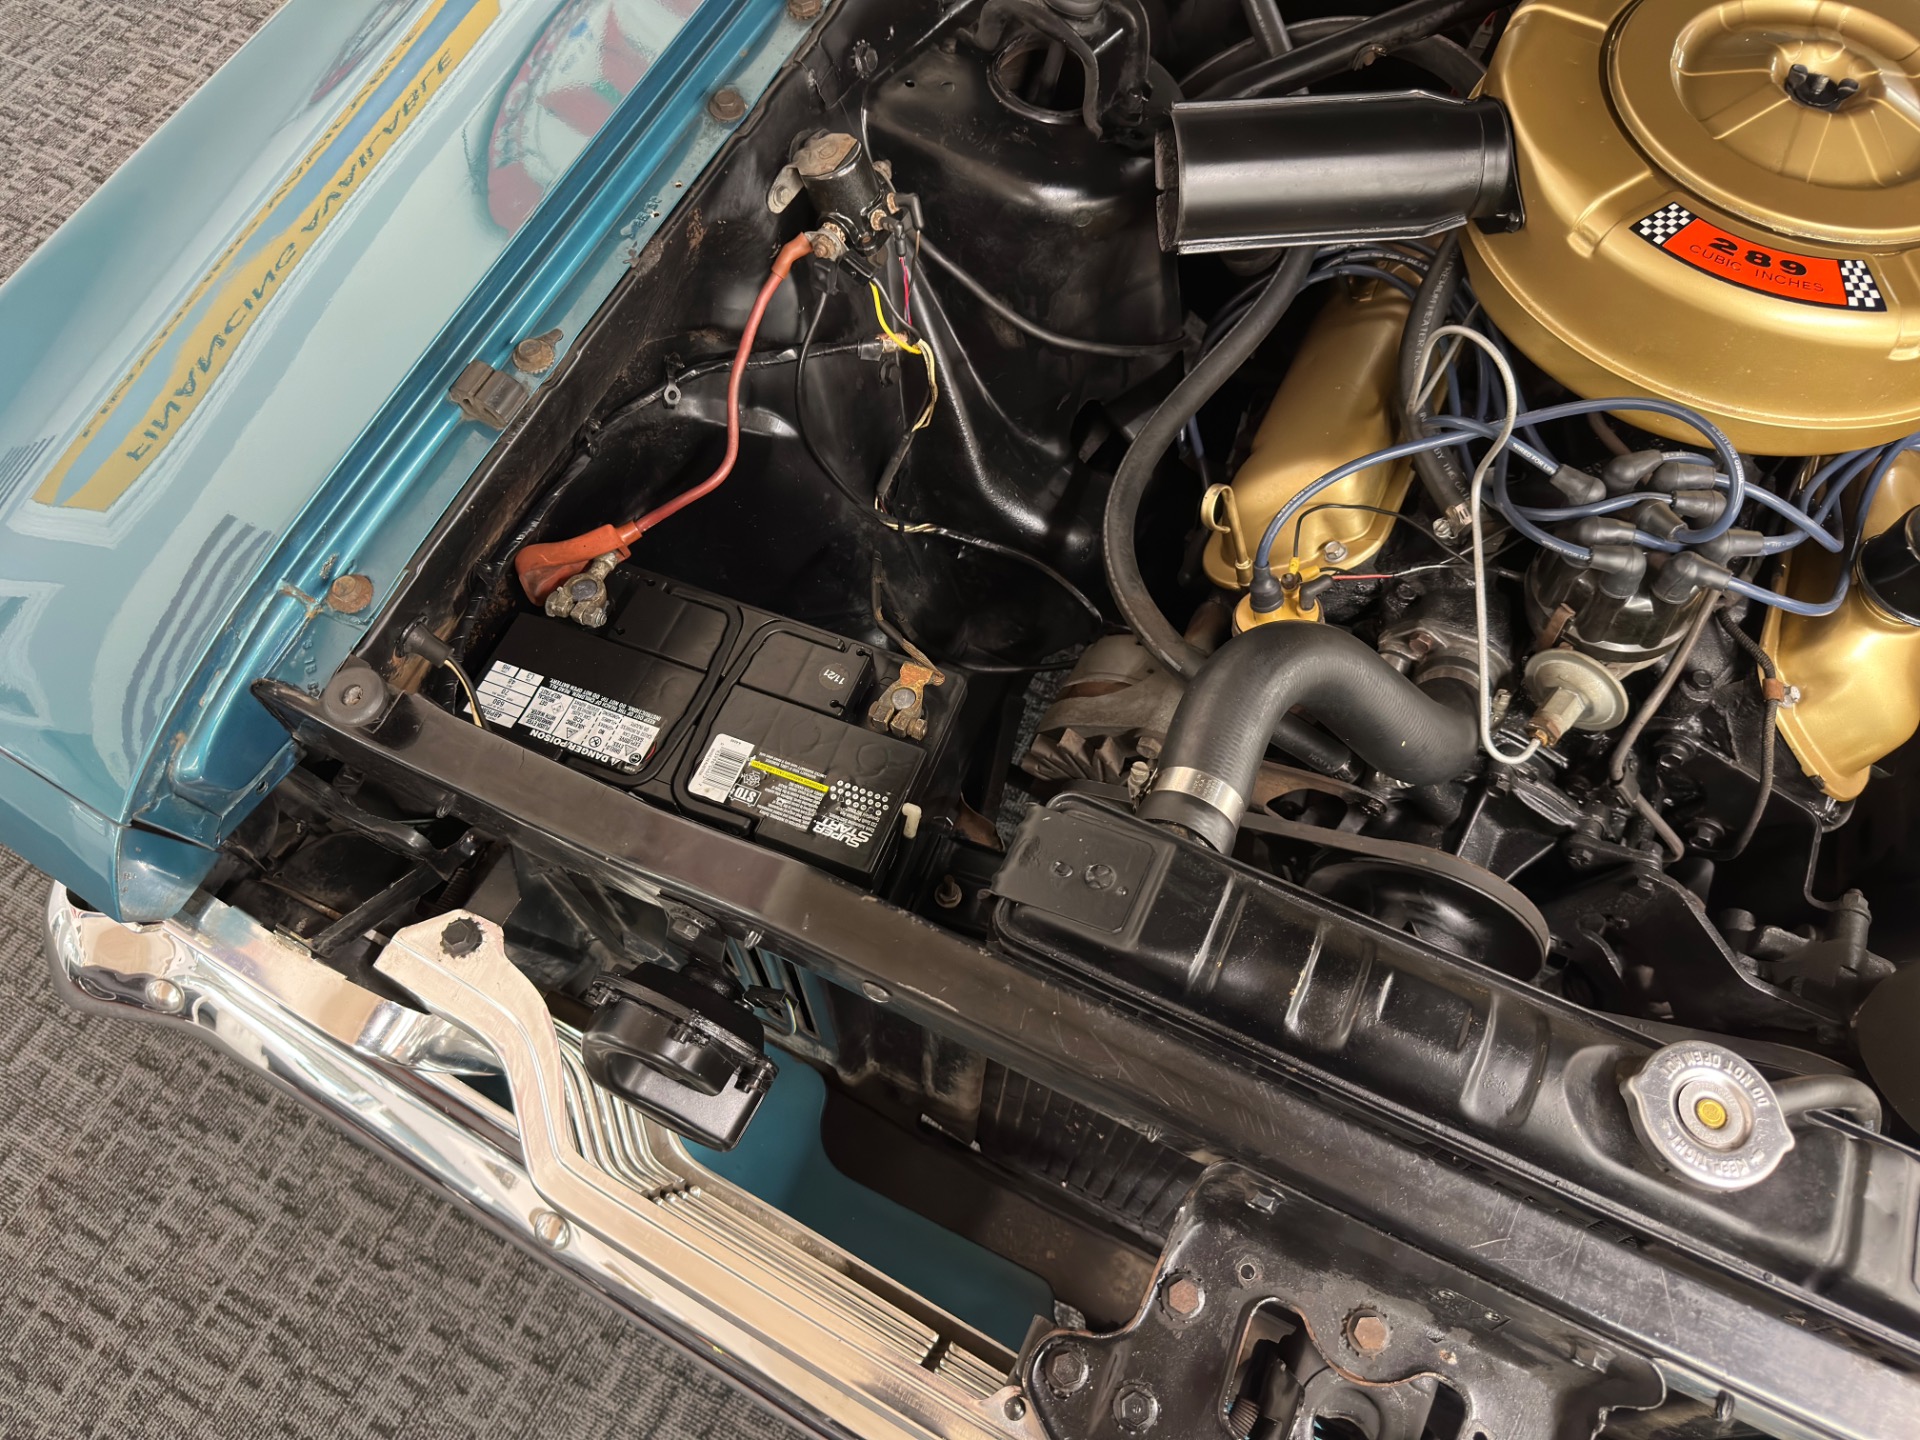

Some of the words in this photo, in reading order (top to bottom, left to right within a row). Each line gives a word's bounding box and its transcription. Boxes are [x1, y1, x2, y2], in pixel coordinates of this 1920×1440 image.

[1689, 244, 1742, 271] CUBIC
[1756, 269, 1824, 292] INCHES
[1709, 237, 1808, 276] 289
[1512, 442, 1533, 458] WIRED
[1531, 455, 1544, 466] FOR
[1734, 459, 1744, 483] WIRED
[823, 668, 846, 685] 11/21
[493, 699, 505, 707] 680
[529, 729, 610, 763] DANGER/POISON
[735, 788, 756, 801] STD
[813, 824, 860, 848] SUPER
[814, 818, 873, 843] START
[1687, 1051, 1722, 1068] OPEN
[1725, 1060, 1753, 1087] NOT
